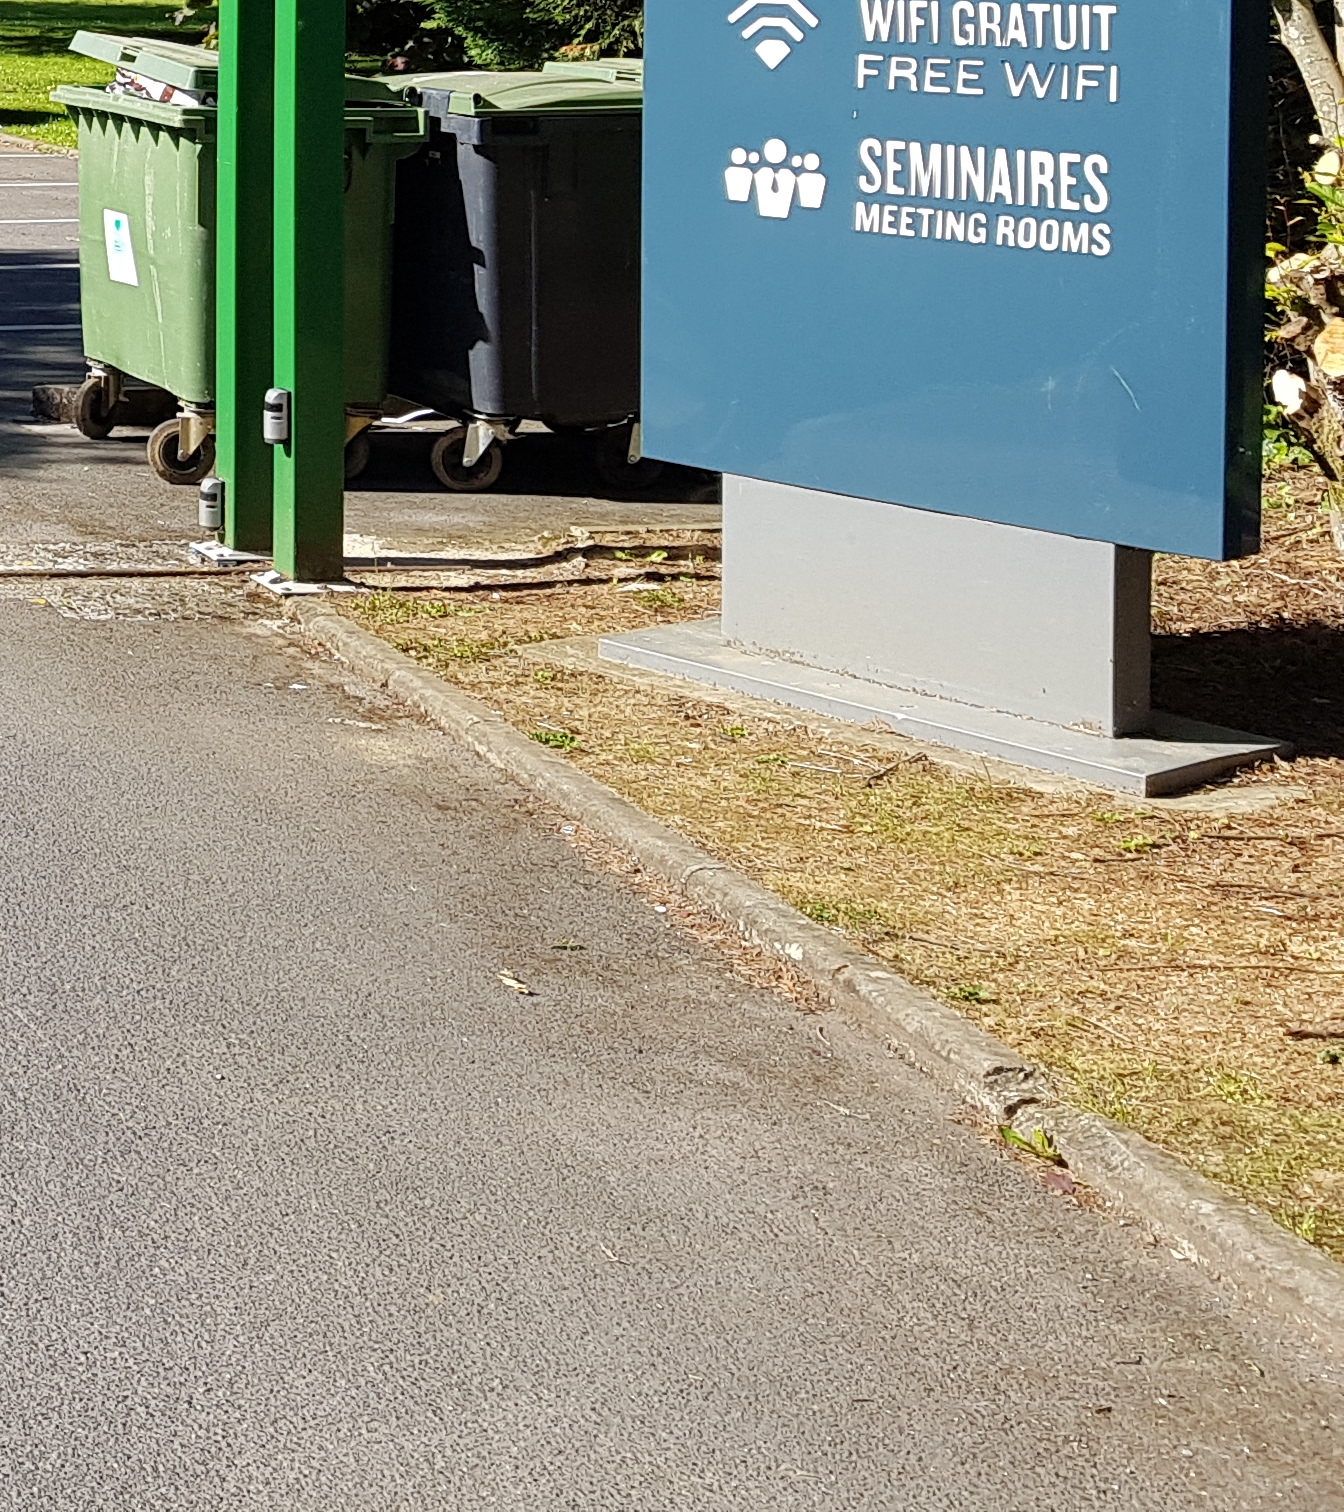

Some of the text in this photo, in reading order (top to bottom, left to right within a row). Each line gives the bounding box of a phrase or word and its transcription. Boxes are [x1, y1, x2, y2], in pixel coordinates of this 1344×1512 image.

[952, 1, 1117, 51] GRATUIT
[857, 54, 1119, 103] FREE WIFI
[858, 138, 1109, 213] SEMINAIRES
[854, 203, 1112, 257] MEETING ROOMS
